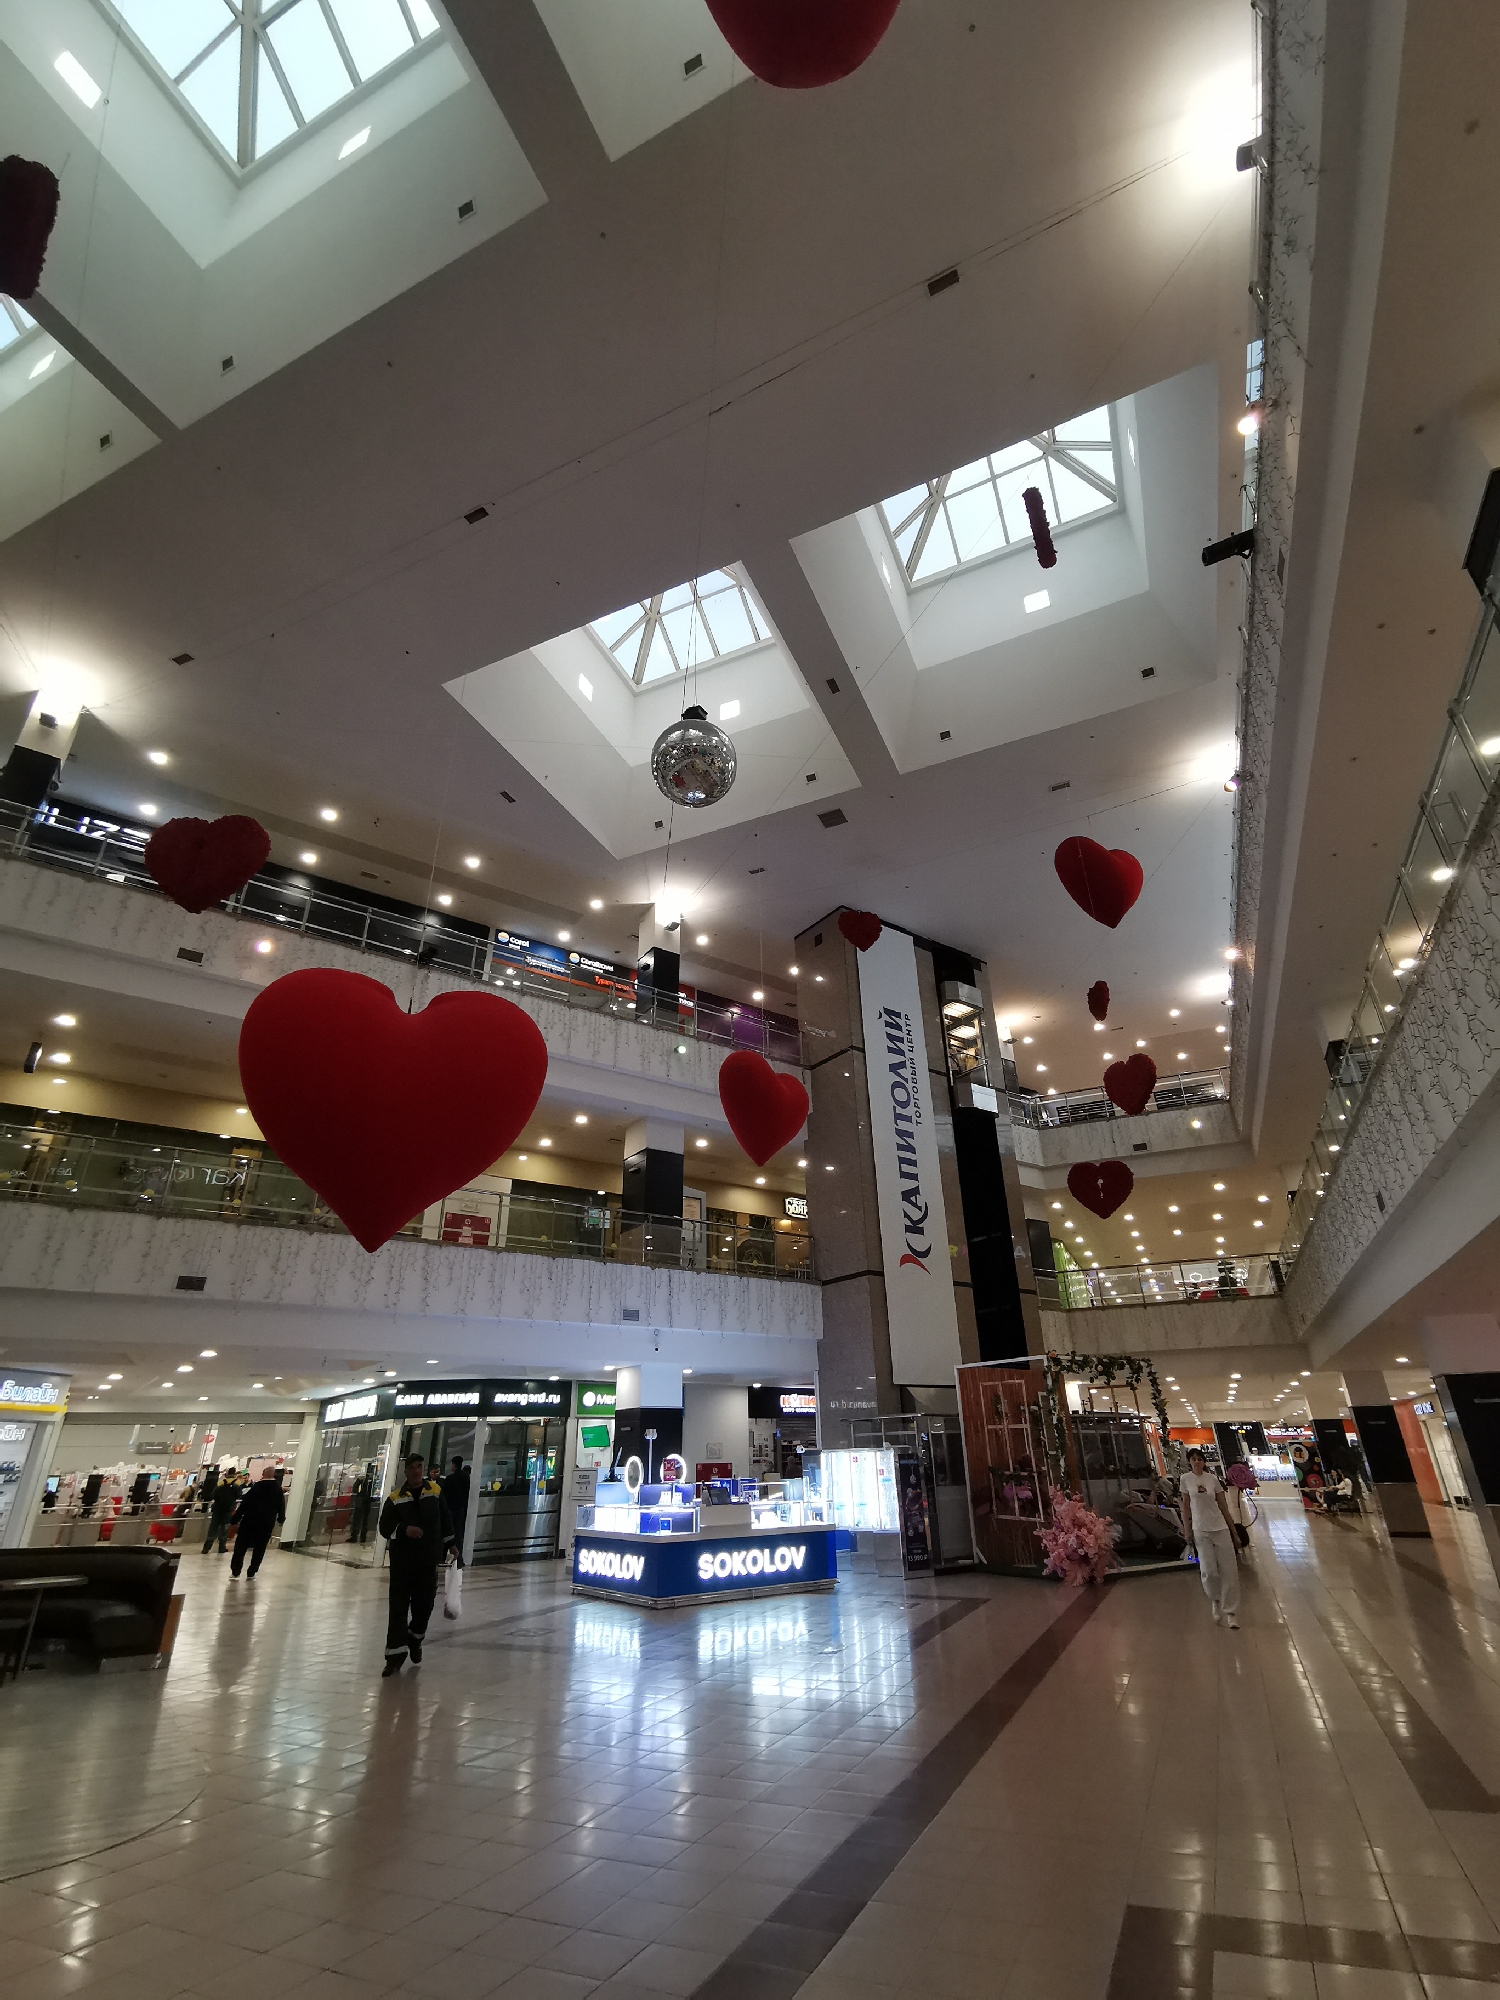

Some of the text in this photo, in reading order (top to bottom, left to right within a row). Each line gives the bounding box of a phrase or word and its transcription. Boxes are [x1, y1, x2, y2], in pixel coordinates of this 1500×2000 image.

[904, 1013, 923, 1126] ТОРГОВЫЙ ЦЕНТР
[877, 1005, 929, 1238] КАПИТОЛИЙ
[2, 1379, 60, 1403] билайн
[494, 1392, 561, 1406] avangard.ru
[578, 1548, 645, 1581] SOKOLOV
[698, 1545, 806, 1580] SOKOLOV
